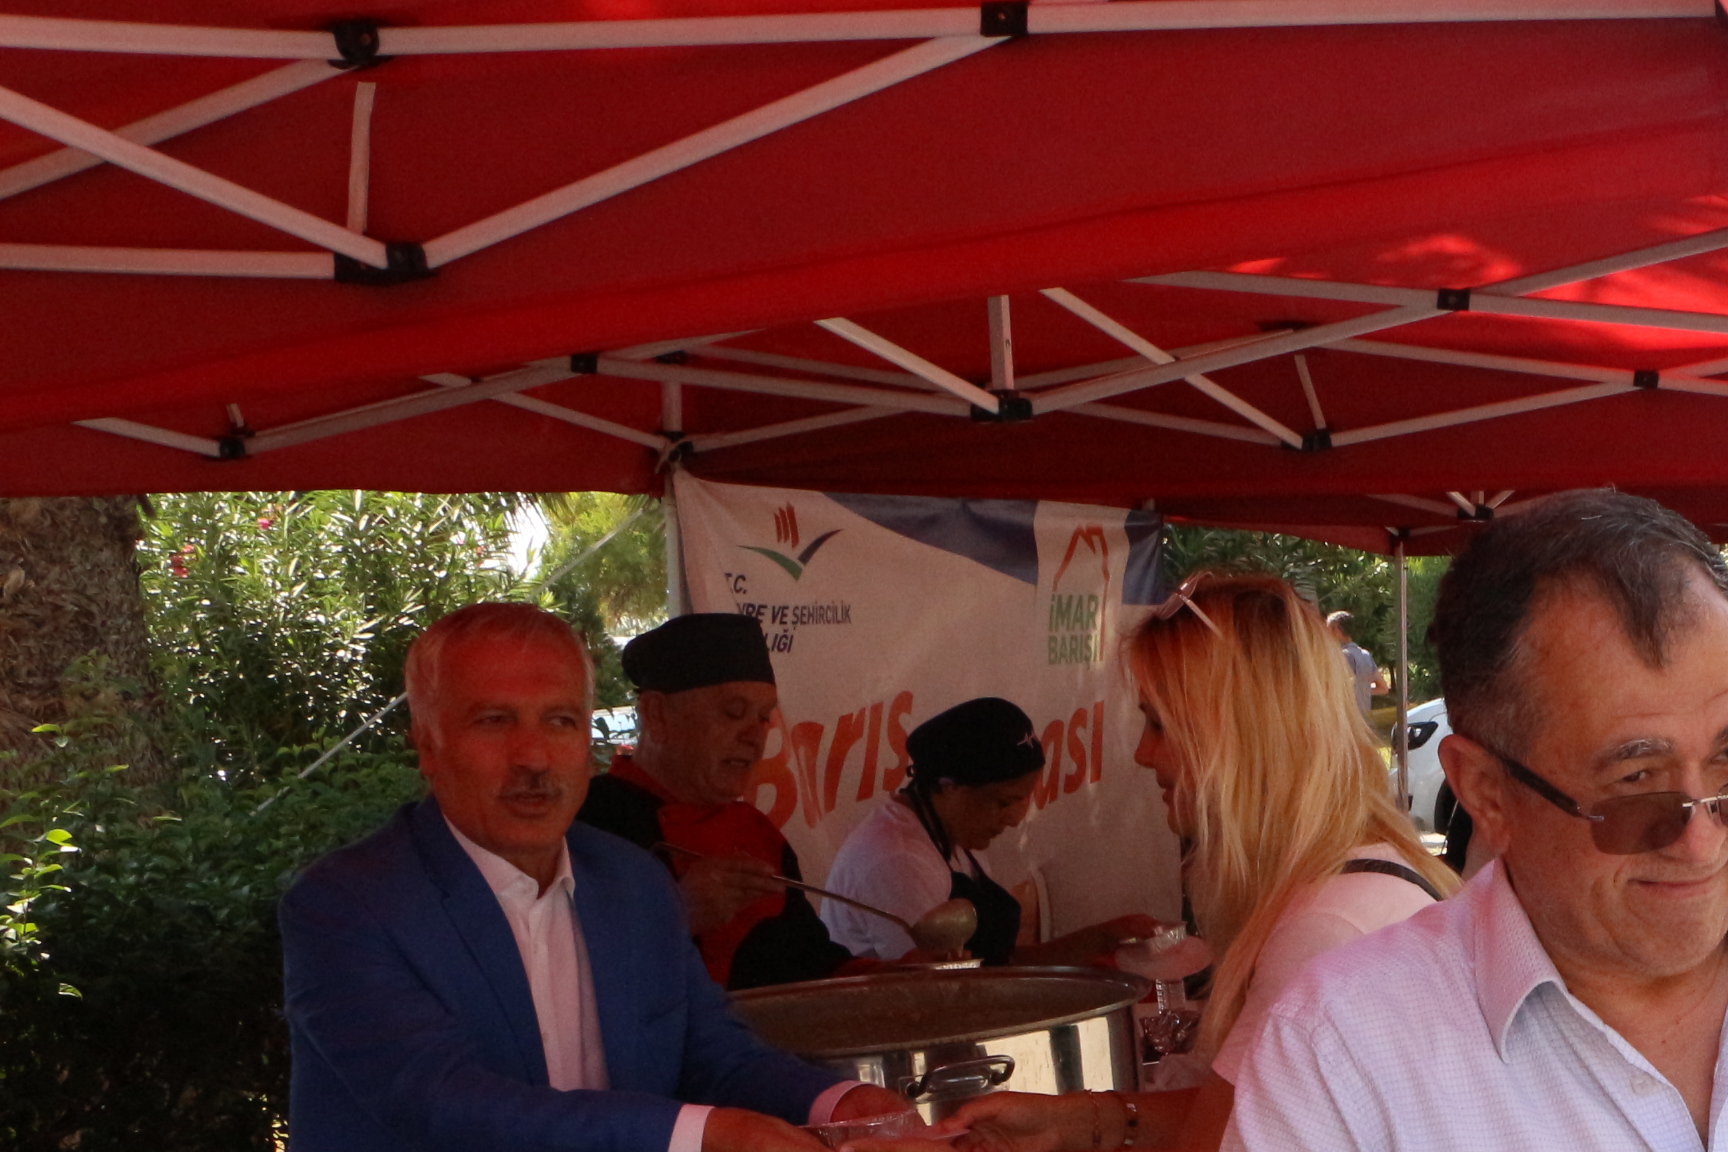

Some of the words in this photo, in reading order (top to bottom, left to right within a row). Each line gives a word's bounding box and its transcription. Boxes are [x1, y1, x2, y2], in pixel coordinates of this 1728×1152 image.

[771, 604, 790, 625] VE
[792, 600, 851, 630] ŞEHİRCİLİK
[1049, 593, 1099, 632] İMAR
[1048, 633, 1099, 671] BARIŞI
